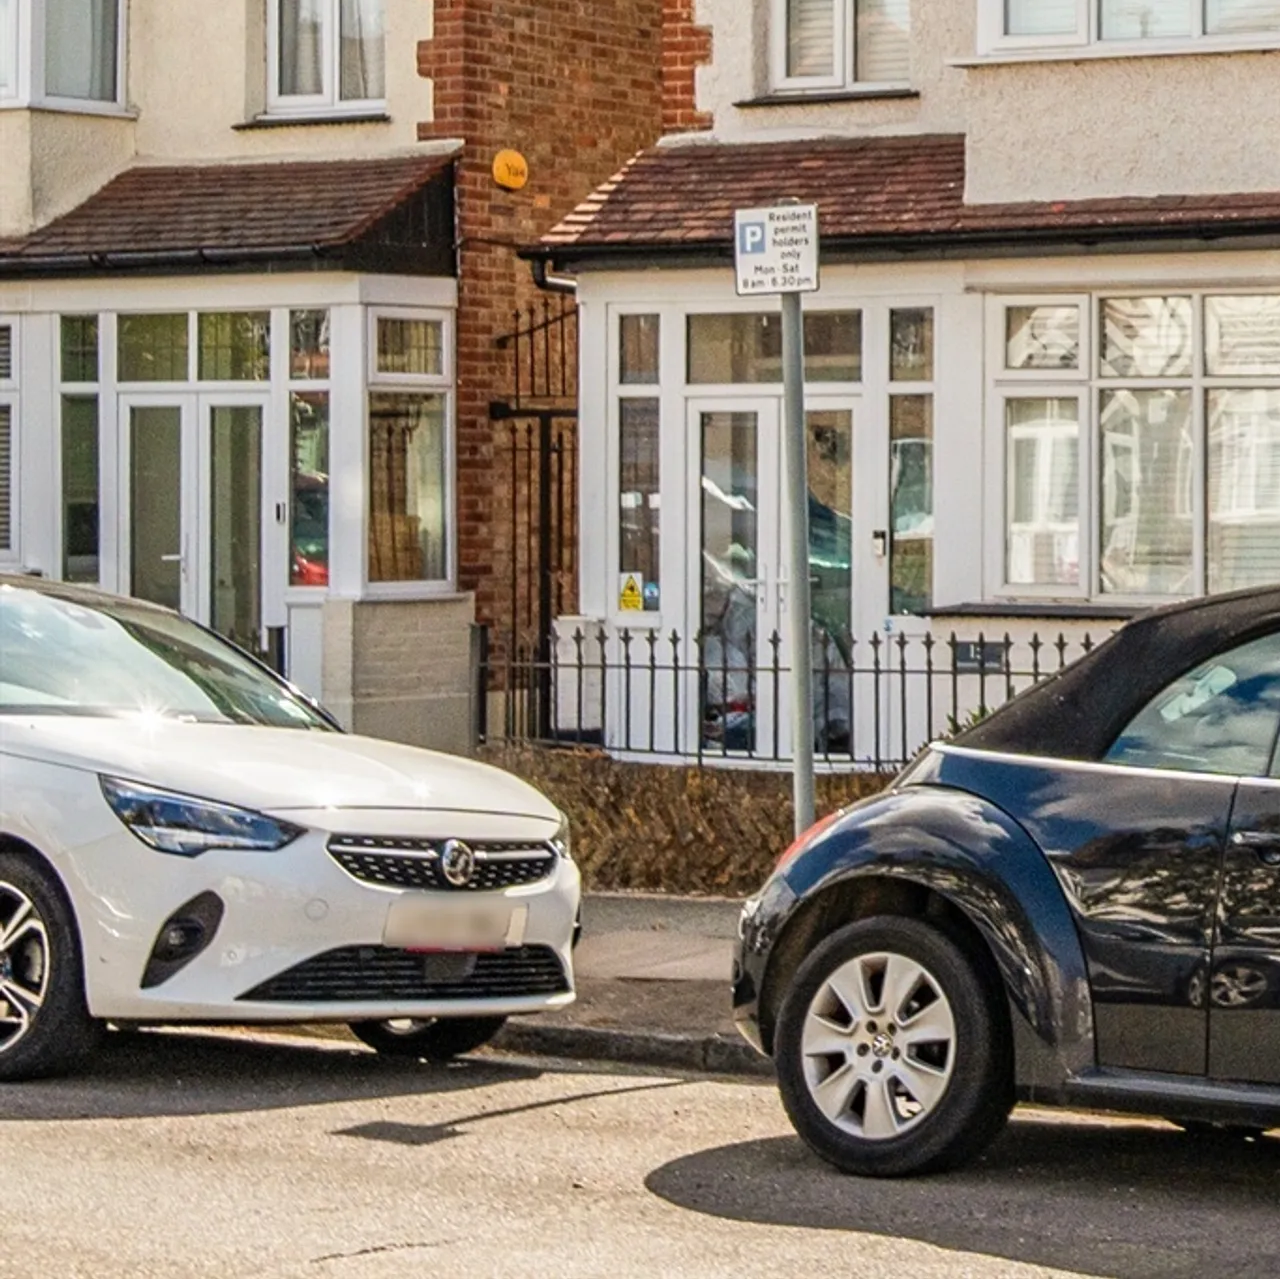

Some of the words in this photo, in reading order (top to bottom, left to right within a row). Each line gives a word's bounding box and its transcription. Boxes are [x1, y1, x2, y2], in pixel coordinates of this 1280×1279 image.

[769, 210, 812, 221] Resident
[774, 224, 807, 235] permit
[745, 225, 762, 252] P
[772, 237, 809, 247] holders
[780, 249, 801, 260] only
[754, 265, 775, 274] Mon
[782, 263, 799, 273] Sat
